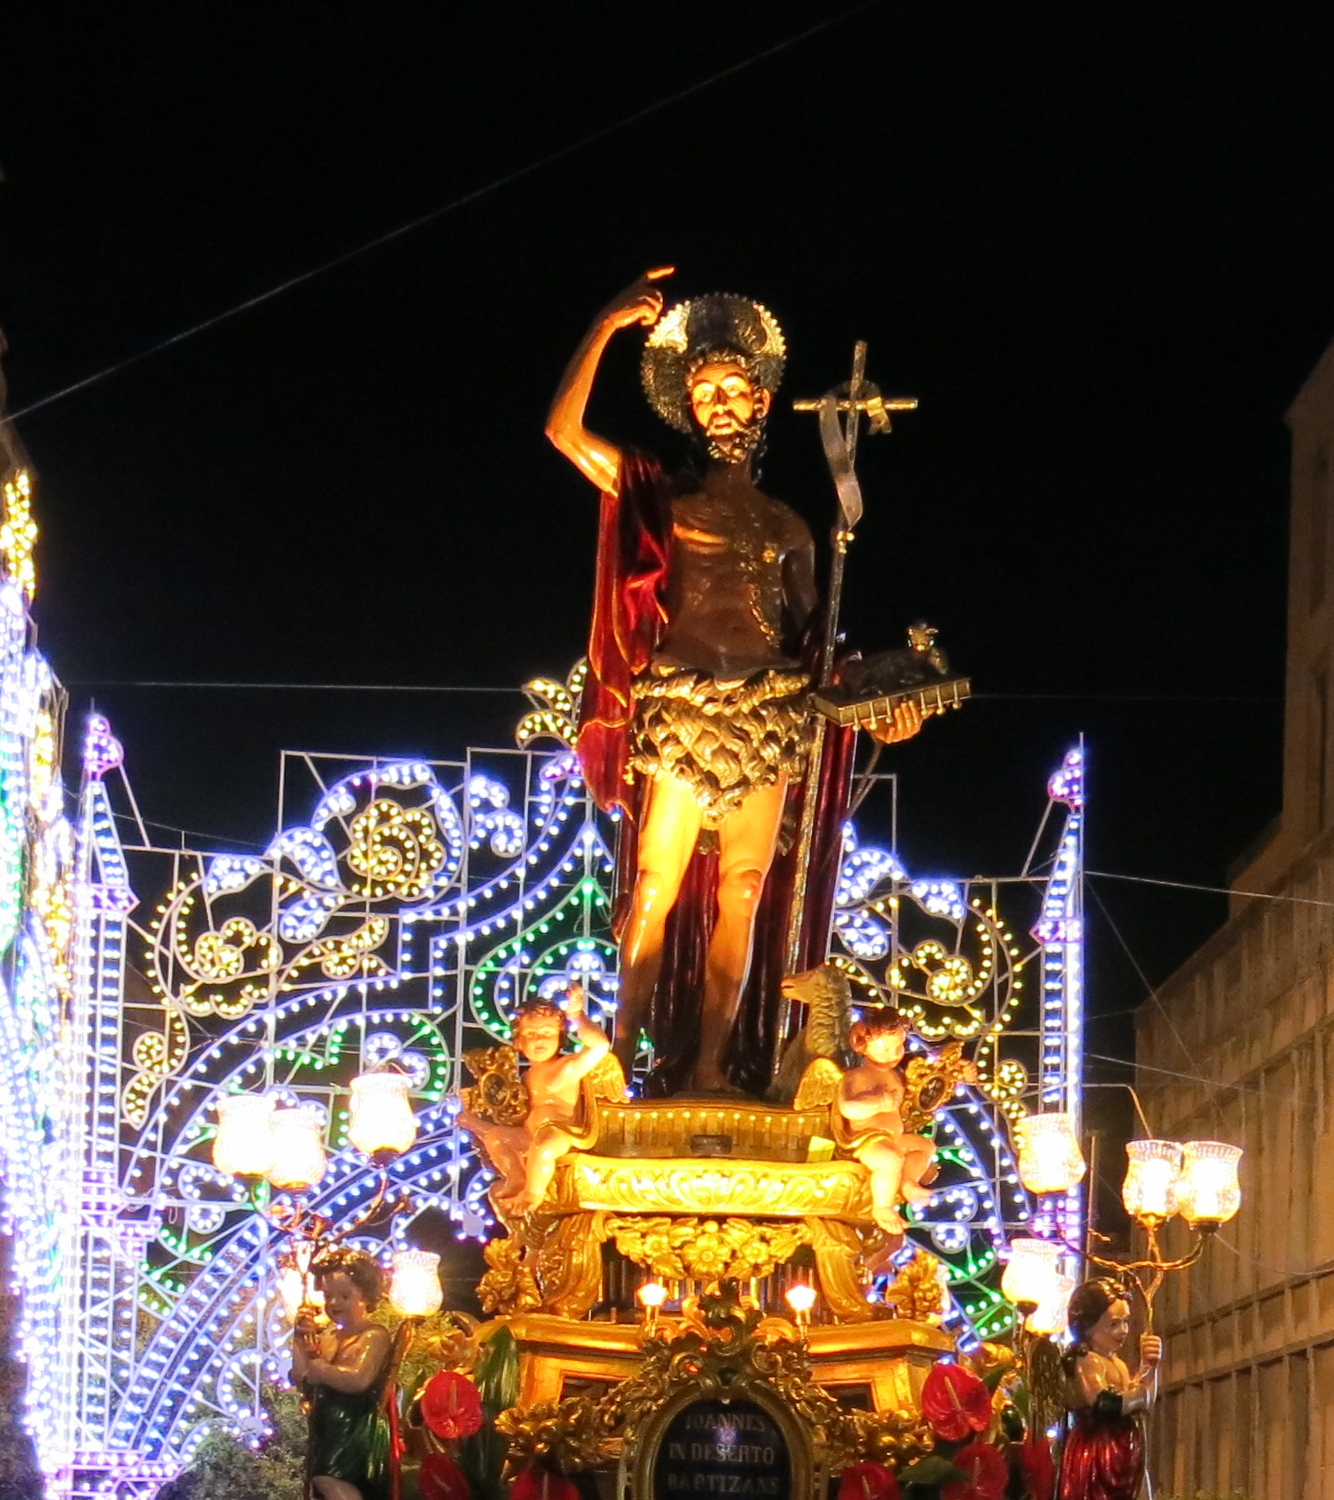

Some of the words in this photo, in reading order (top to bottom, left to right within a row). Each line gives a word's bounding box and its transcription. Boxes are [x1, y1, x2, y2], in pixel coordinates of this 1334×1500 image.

[669, 1443, 686, 1459] IN
[692, 1443, 775, 1464] DESERTO
[668, 1474, 779, 1494] BAPTIZANS
